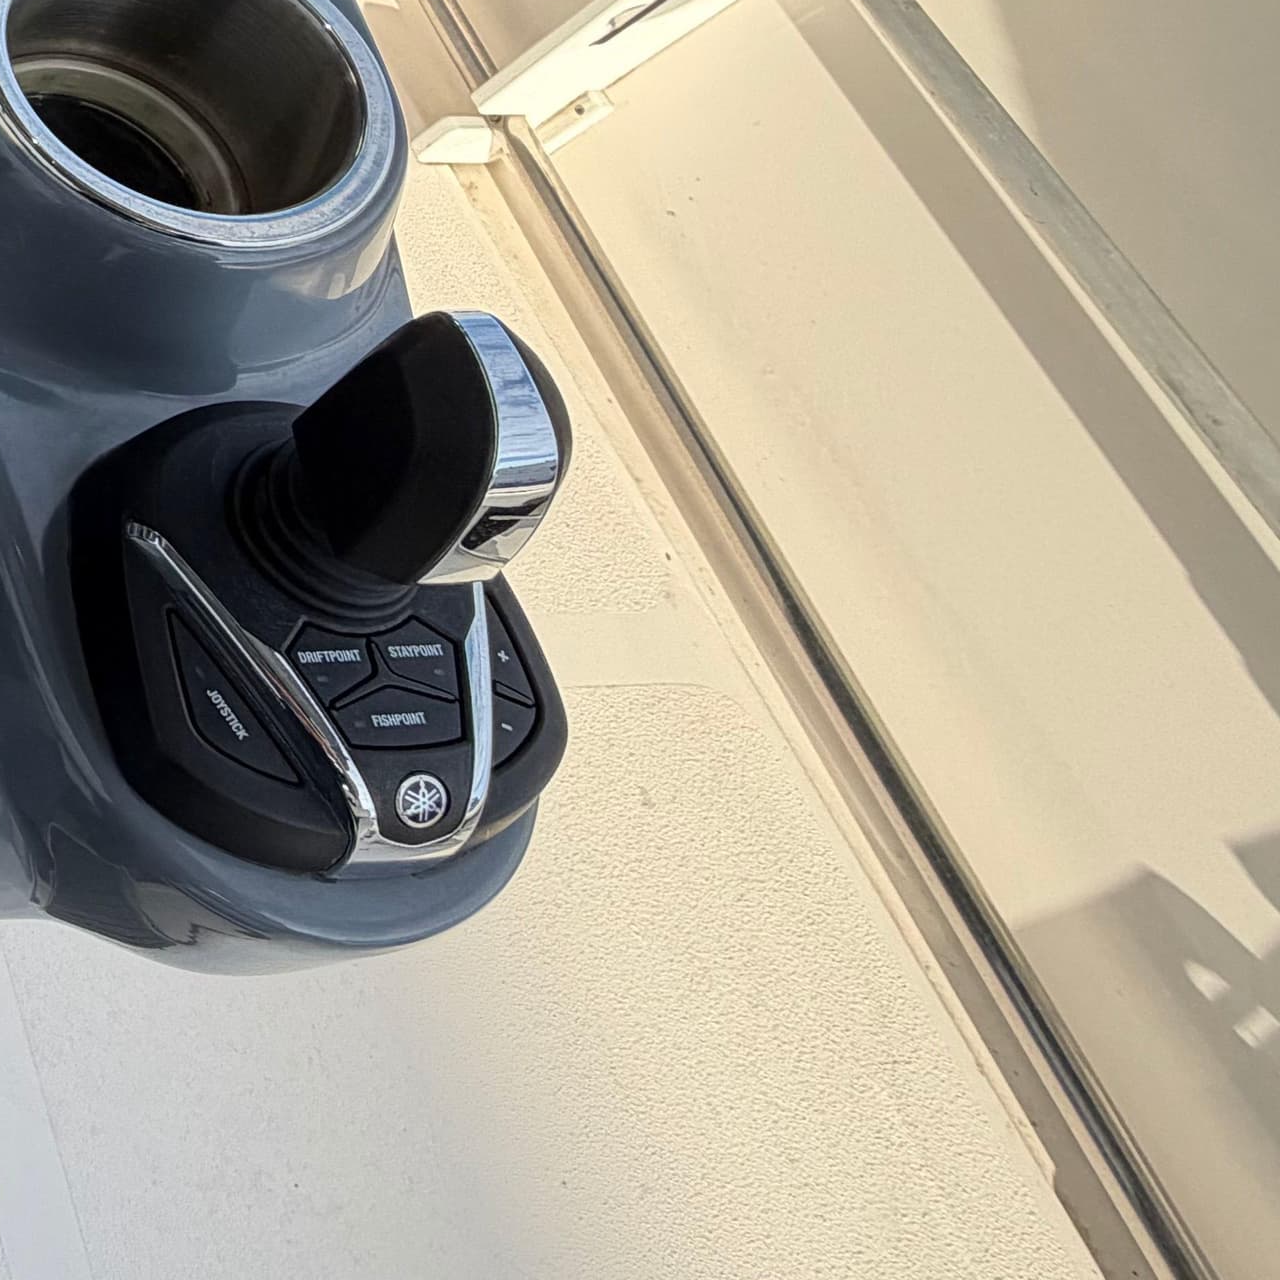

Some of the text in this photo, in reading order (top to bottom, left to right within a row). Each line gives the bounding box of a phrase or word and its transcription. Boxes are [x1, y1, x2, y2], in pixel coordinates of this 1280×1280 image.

[297, 649, 362, 664] DRIFTPOINT
[387, 644, 444, 659] STAYPOINT
[205, 687, 250, 742] JOYSTICK
[371, 711, 427, 728] FISHPOINT
